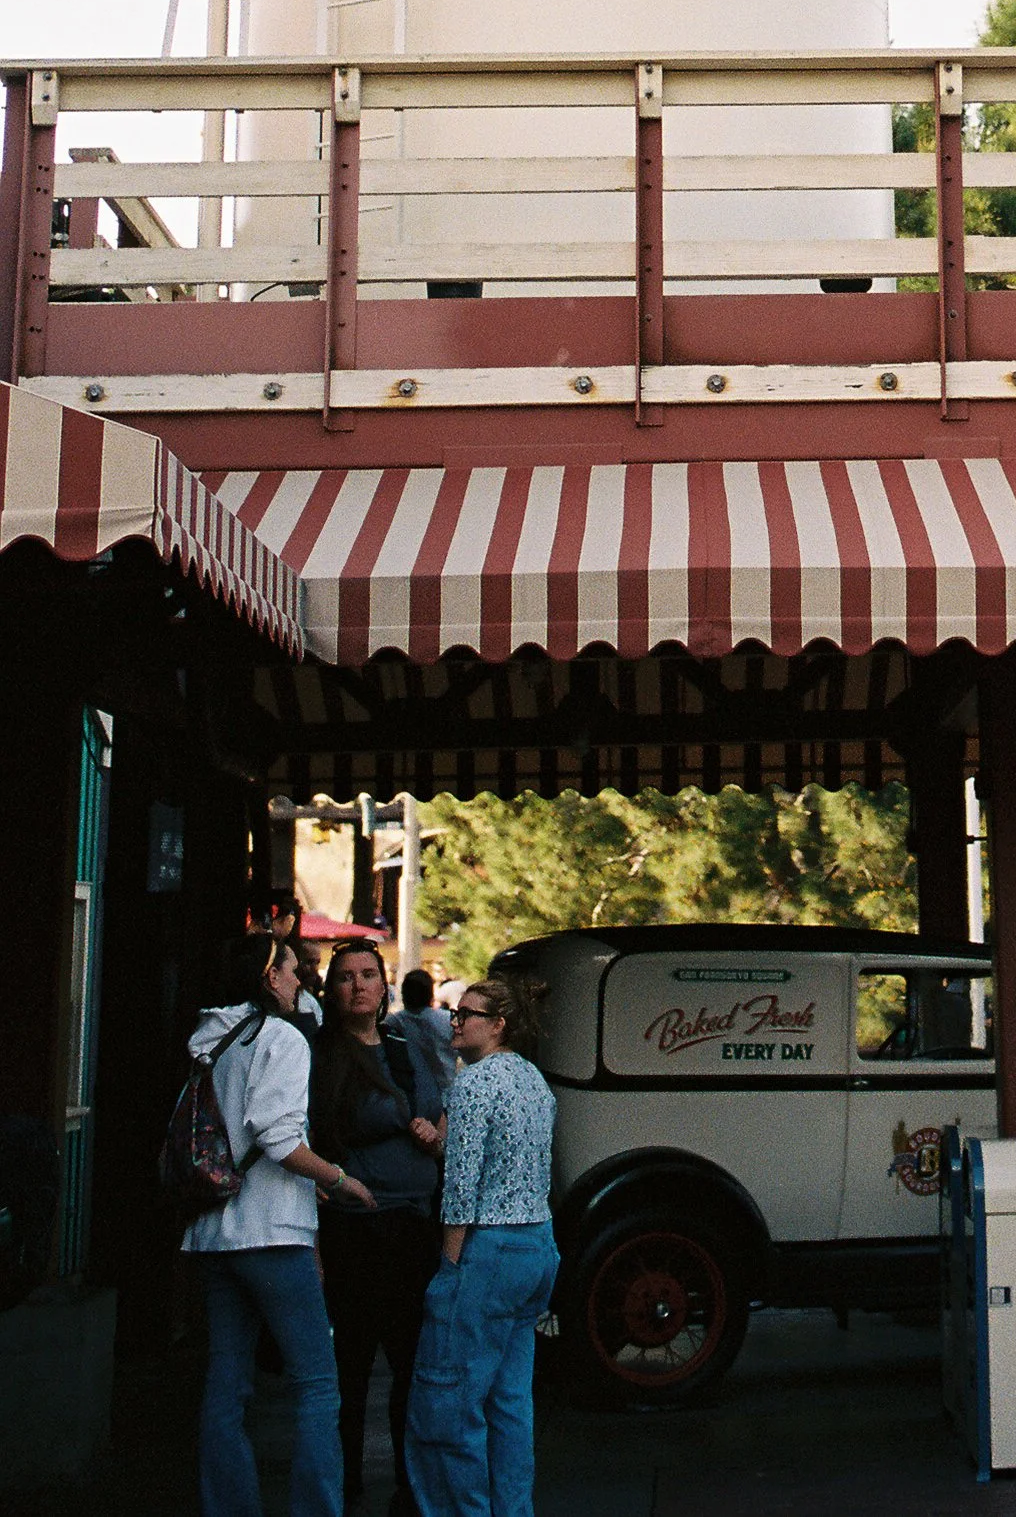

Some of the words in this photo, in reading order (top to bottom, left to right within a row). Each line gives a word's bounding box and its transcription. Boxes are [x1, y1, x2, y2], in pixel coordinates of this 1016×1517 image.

[644, 1001, 741, 1051] Baked
[742, 994, 816, 1034] Fresh
[722, 1043, 776, 1060] EVERY
[781, 1043, 815, 1060] DAY
